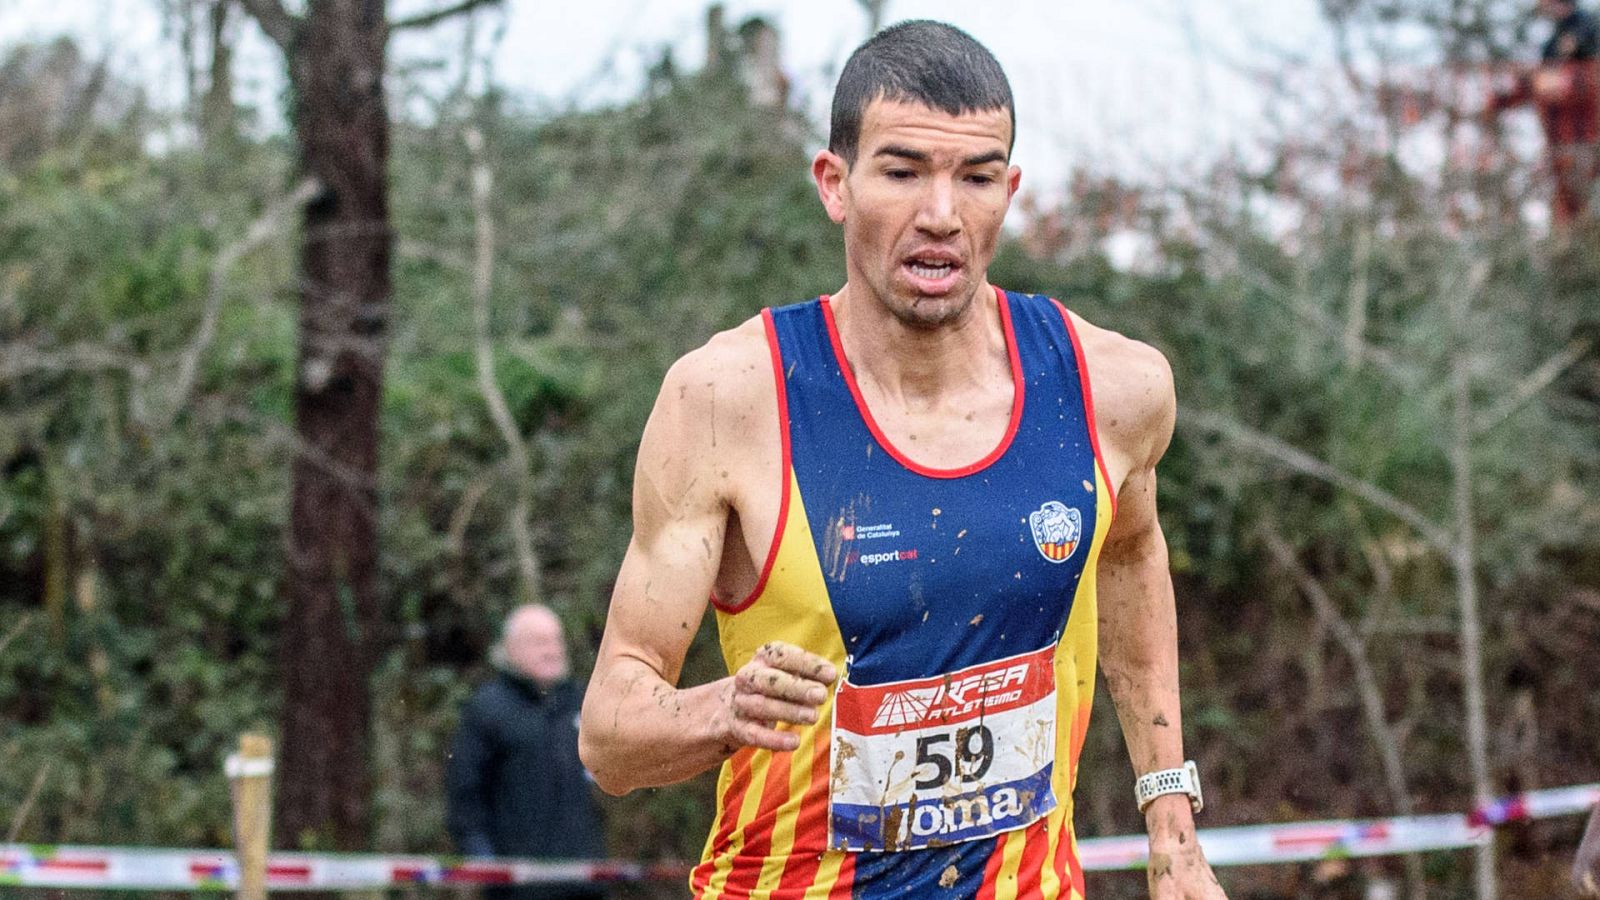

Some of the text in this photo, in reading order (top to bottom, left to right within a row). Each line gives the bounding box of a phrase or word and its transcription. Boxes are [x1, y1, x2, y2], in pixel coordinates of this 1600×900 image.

[856, 523, 893, 533] Generalitat
[866, 530, 900, 539] Catalunya
[860, 549, 918, 565] esportcat
[914, 725, 994, 790] 59
